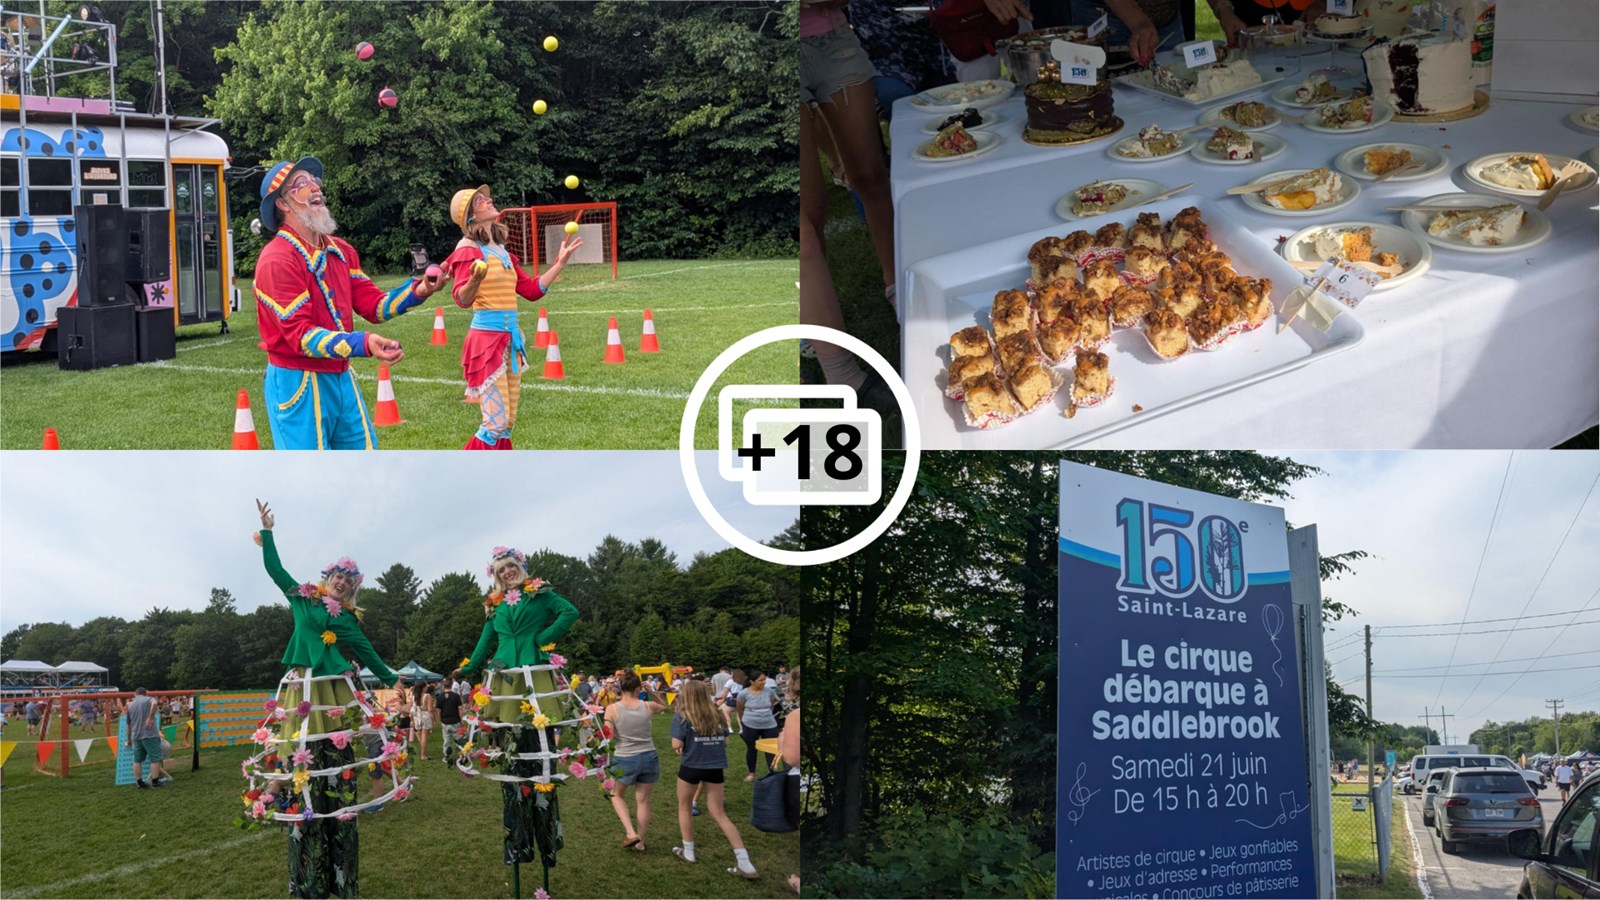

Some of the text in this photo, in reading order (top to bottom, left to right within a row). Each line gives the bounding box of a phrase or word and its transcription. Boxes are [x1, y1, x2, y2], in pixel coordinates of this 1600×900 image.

[1338, 274, 1349, 284] 6
[1117, 595, 1248, 623] Saint-Lazare
[1121, 638, 1253, 676] Le cirque
[1103, 673, 1269, 709] débarque à
[1092, 709, 1281, 740] Saddlebrook
[1111, 751, 1267, 780] Samedi 21 juin
[1114, 781, 1268, 814] De 15 h à 20 h
[1076, 838, 1299, 872] Artistes de cirque Jeux gonflables
[1097, 874, 1132, 890] Jeux
[1210, 858, 1293, 878] Performances
[1162, 884, 1225, 899] Concours
[1226, 880, 1243, 896] de
[1245, 874, 1300, 896] pâtisserie
